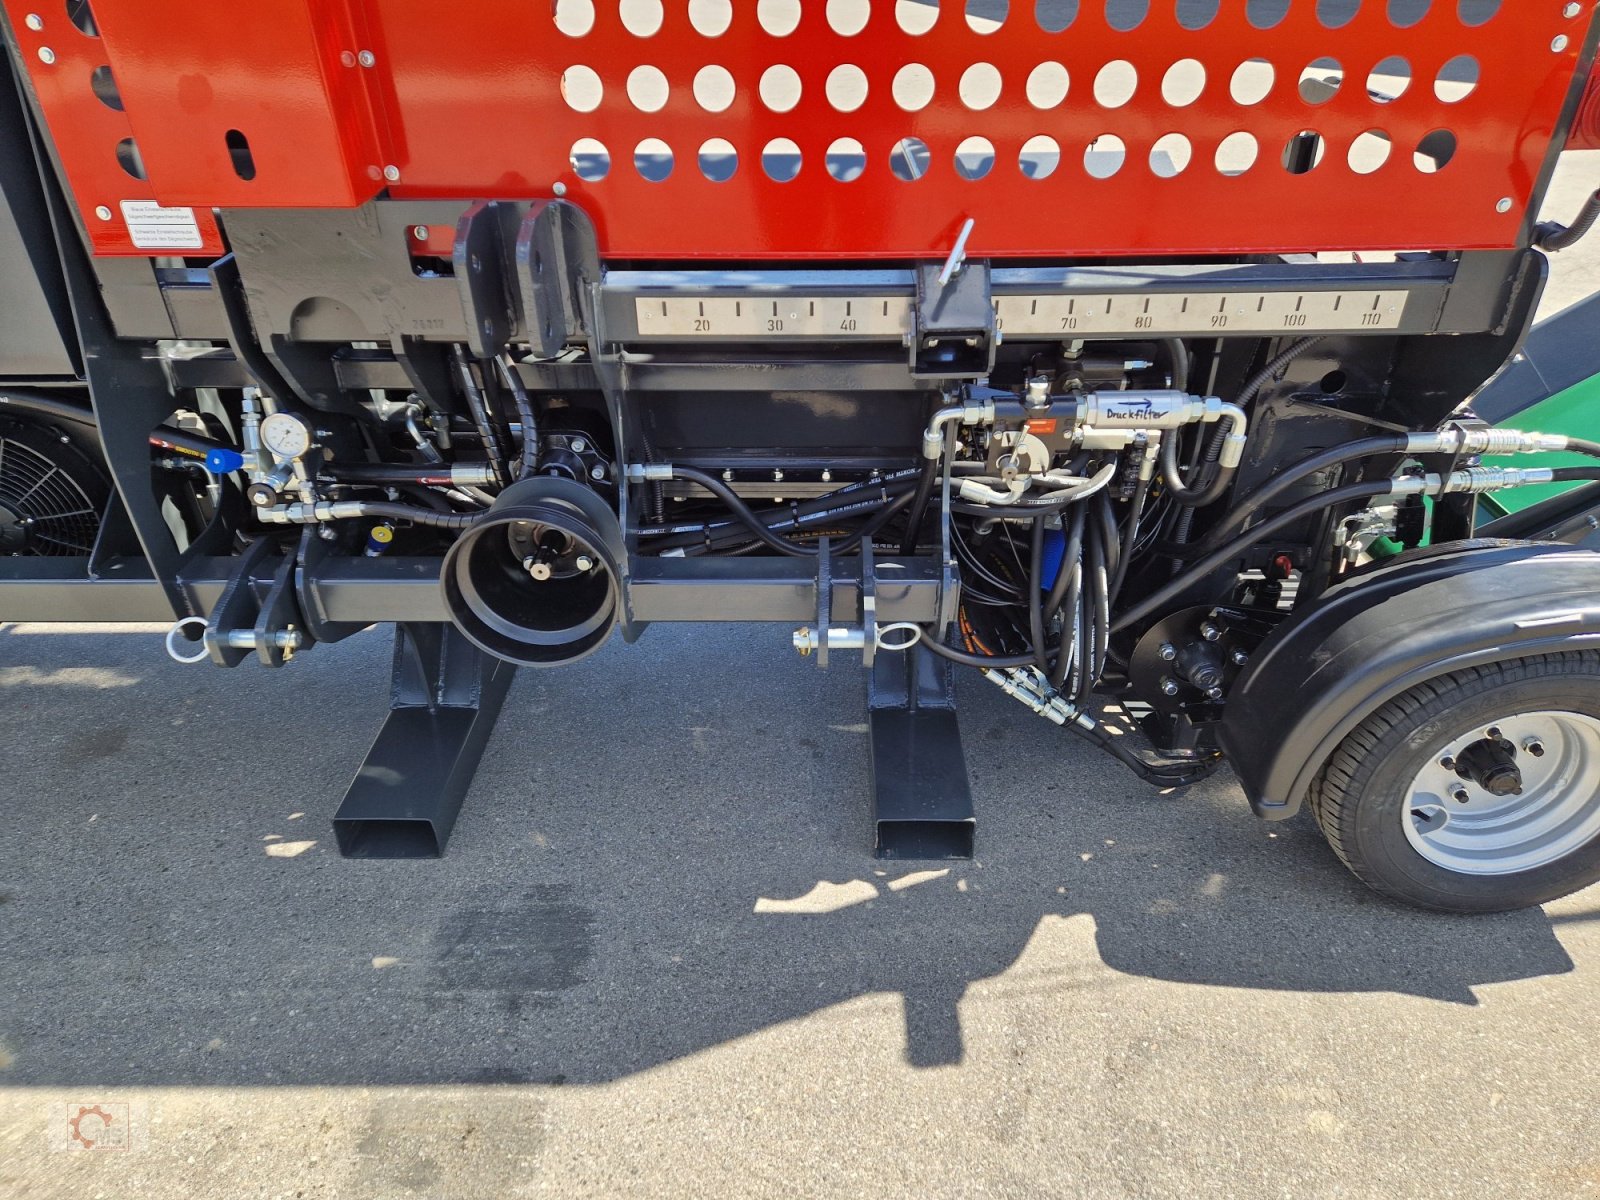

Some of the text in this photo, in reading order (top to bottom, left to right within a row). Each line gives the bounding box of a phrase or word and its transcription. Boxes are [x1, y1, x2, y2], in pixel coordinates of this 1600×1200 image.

[694, 313, 1382, 332] 20 30 40 0 70 80 90 100 110
[1107, 408, 1168, 420] Druckfilter
